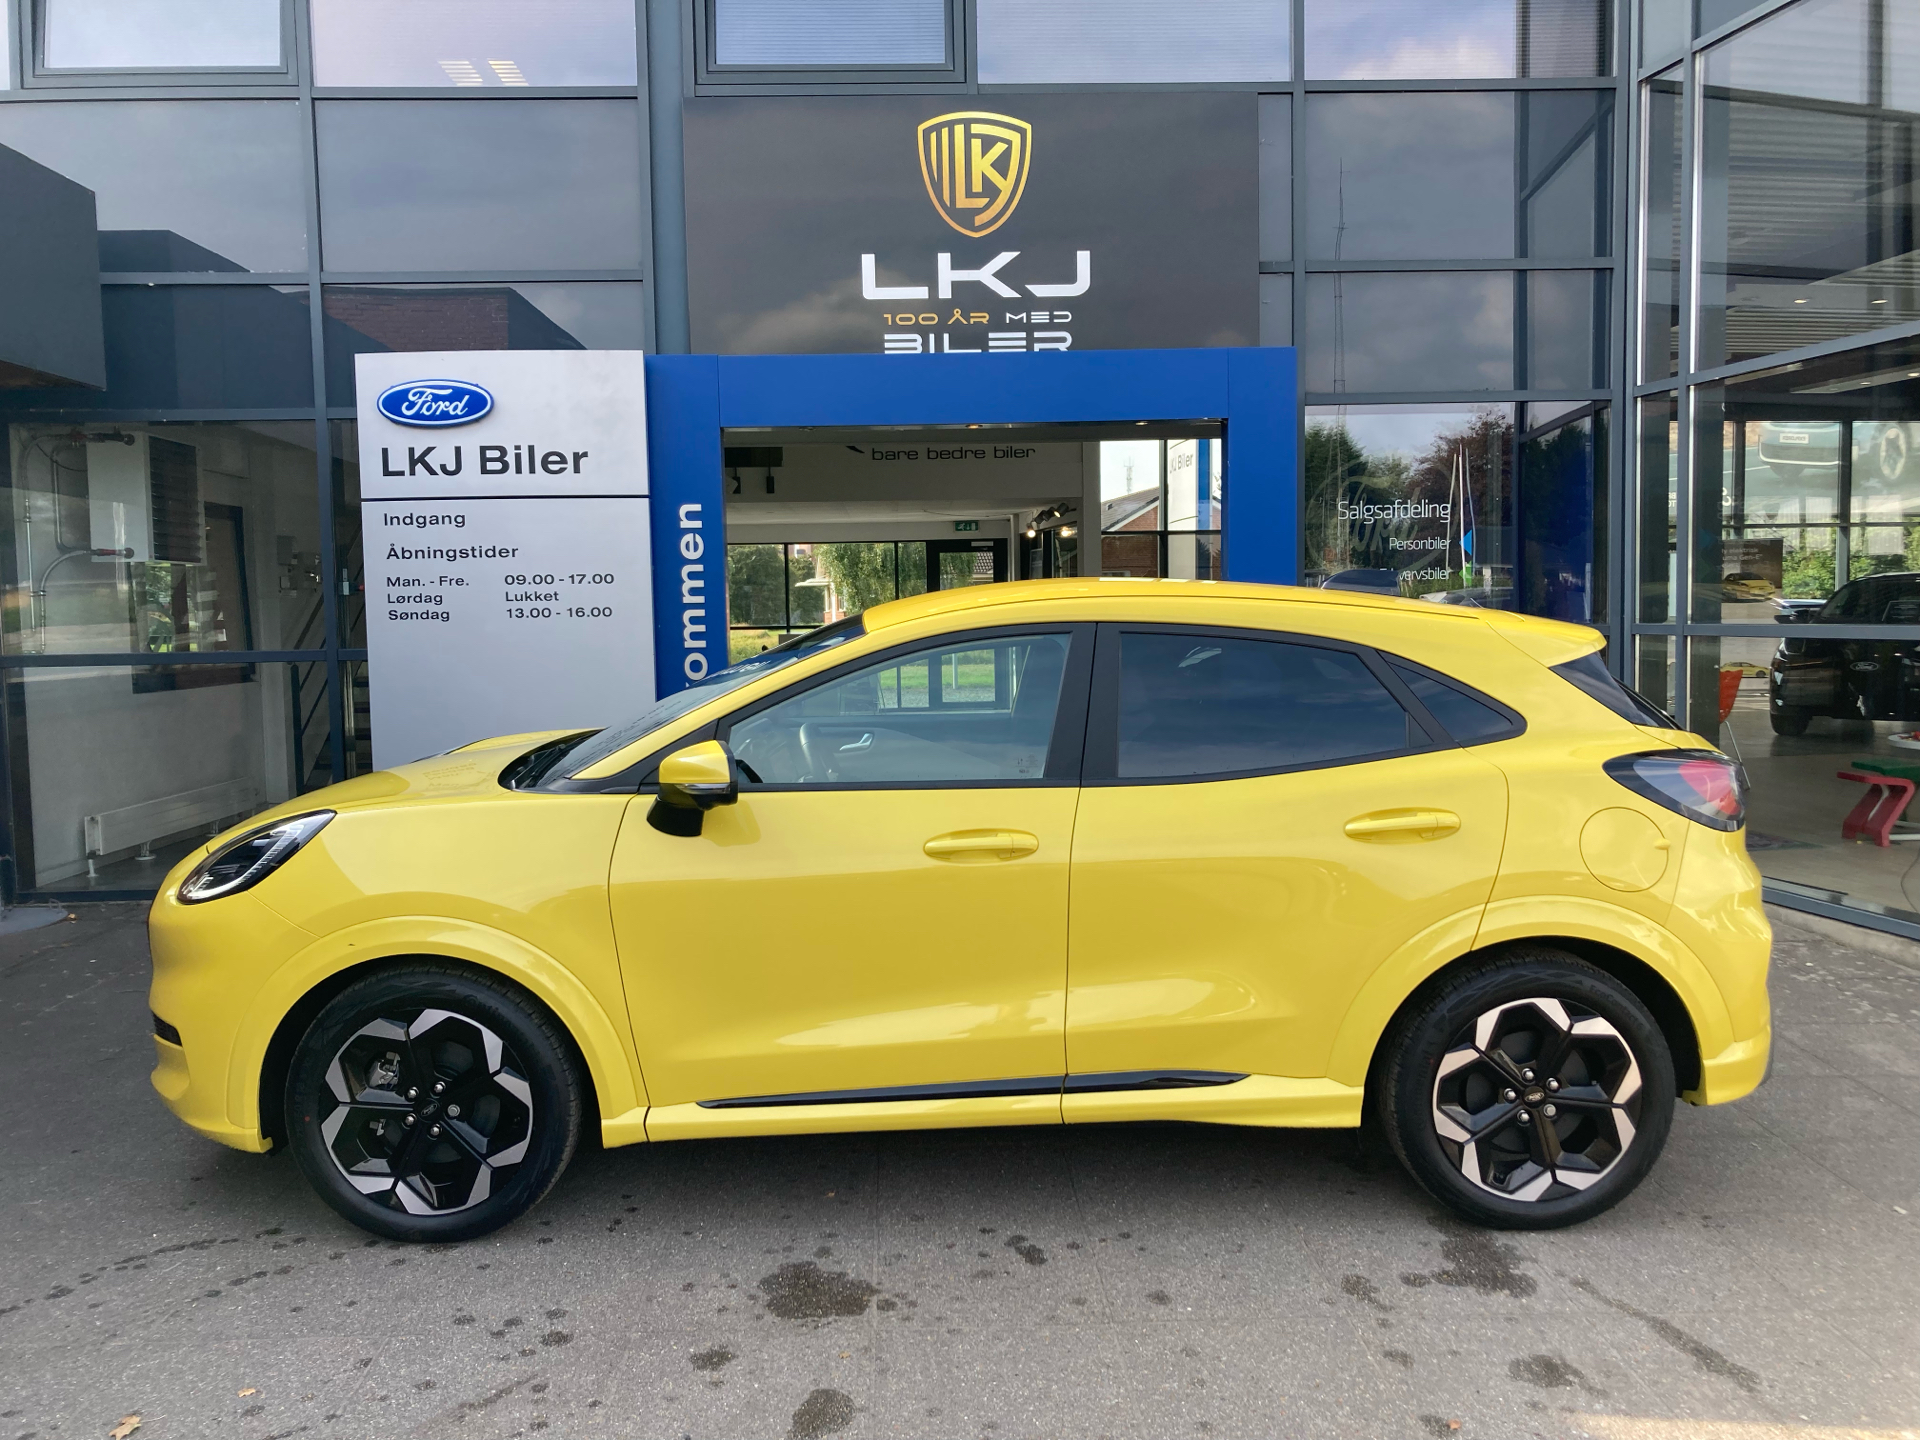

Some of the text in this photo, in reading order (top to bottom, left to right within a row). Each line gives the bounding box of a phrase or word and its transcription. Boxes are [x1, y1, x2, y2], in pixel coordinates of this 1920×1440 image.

[861, 250, 1091, 300] LKJ
[883, 308, 1072, 326] 100 ÅR MED
[884, 331, 1073, 354] BILER
[401, 386, 469, 418] Ford
[381, 444, 589, 477] LKJ Biler
[871, 445, 1036, 461] bare bedre biler
[383, 512, 466, 528] Indgang
[1337, 499, 1451, 525] Salgsafdeling
[386, 542, 519, 562] Åbningstider
[1389, 536, 1451, 551] Personbiler
[386, 576, 426, 588] Man.
[439, 576, 469, 587] Fre.
[504, 574, 555, 586] 09.00
[568, 573, 615, 585] 17.00
[1380, 566, 1450, 581] vervsbiler
[387, 591, 559, 606] Lørdag Lukket
[679, 503, 709, 687] ommen
[388, 609, 450, 622] Søndag
[506, 607, 552, 619] 13.00
[567, 606, 613, 618] 16.00
